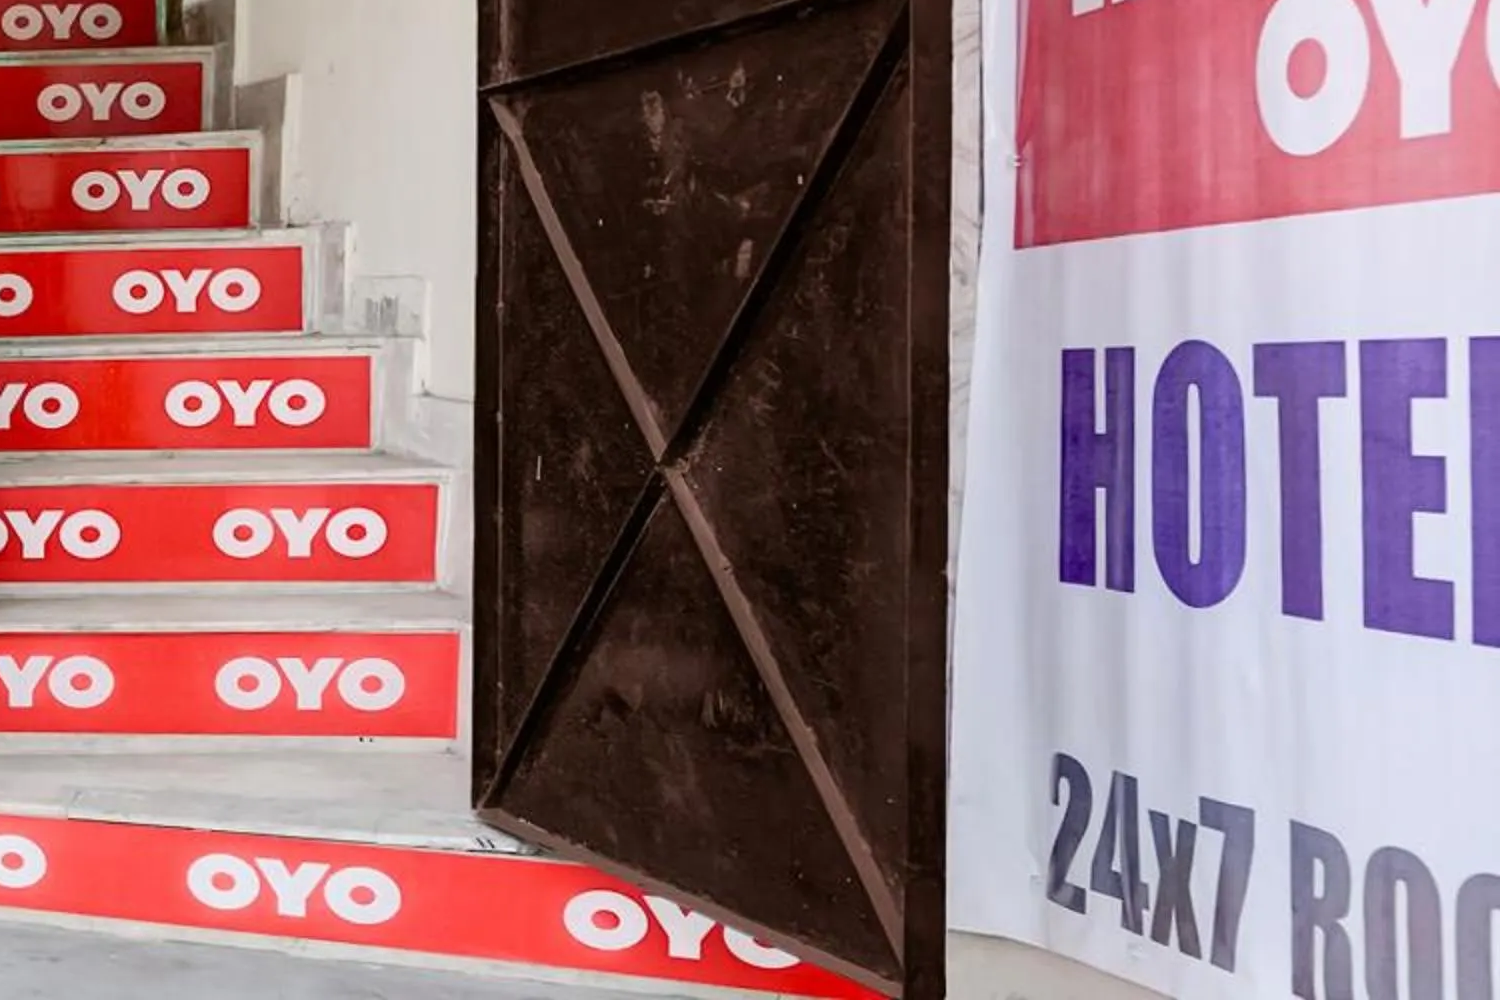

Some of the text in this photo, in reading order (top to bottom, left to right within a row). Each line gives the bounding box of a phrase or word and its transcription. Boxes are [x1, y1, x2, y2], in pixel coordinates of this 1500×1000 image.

[1, 3, 122, 41] OYO
[37, 81, 166, 122] OYO
[71, 168, 211, 211] OYO
[112, 267, 261, 314] OYO
[164, 379, 326, 427] OYO
[212, 507, 387, 559] OYO
[214, 656, 406, 711] OYO
[186, 852, 401, 925] OYO
